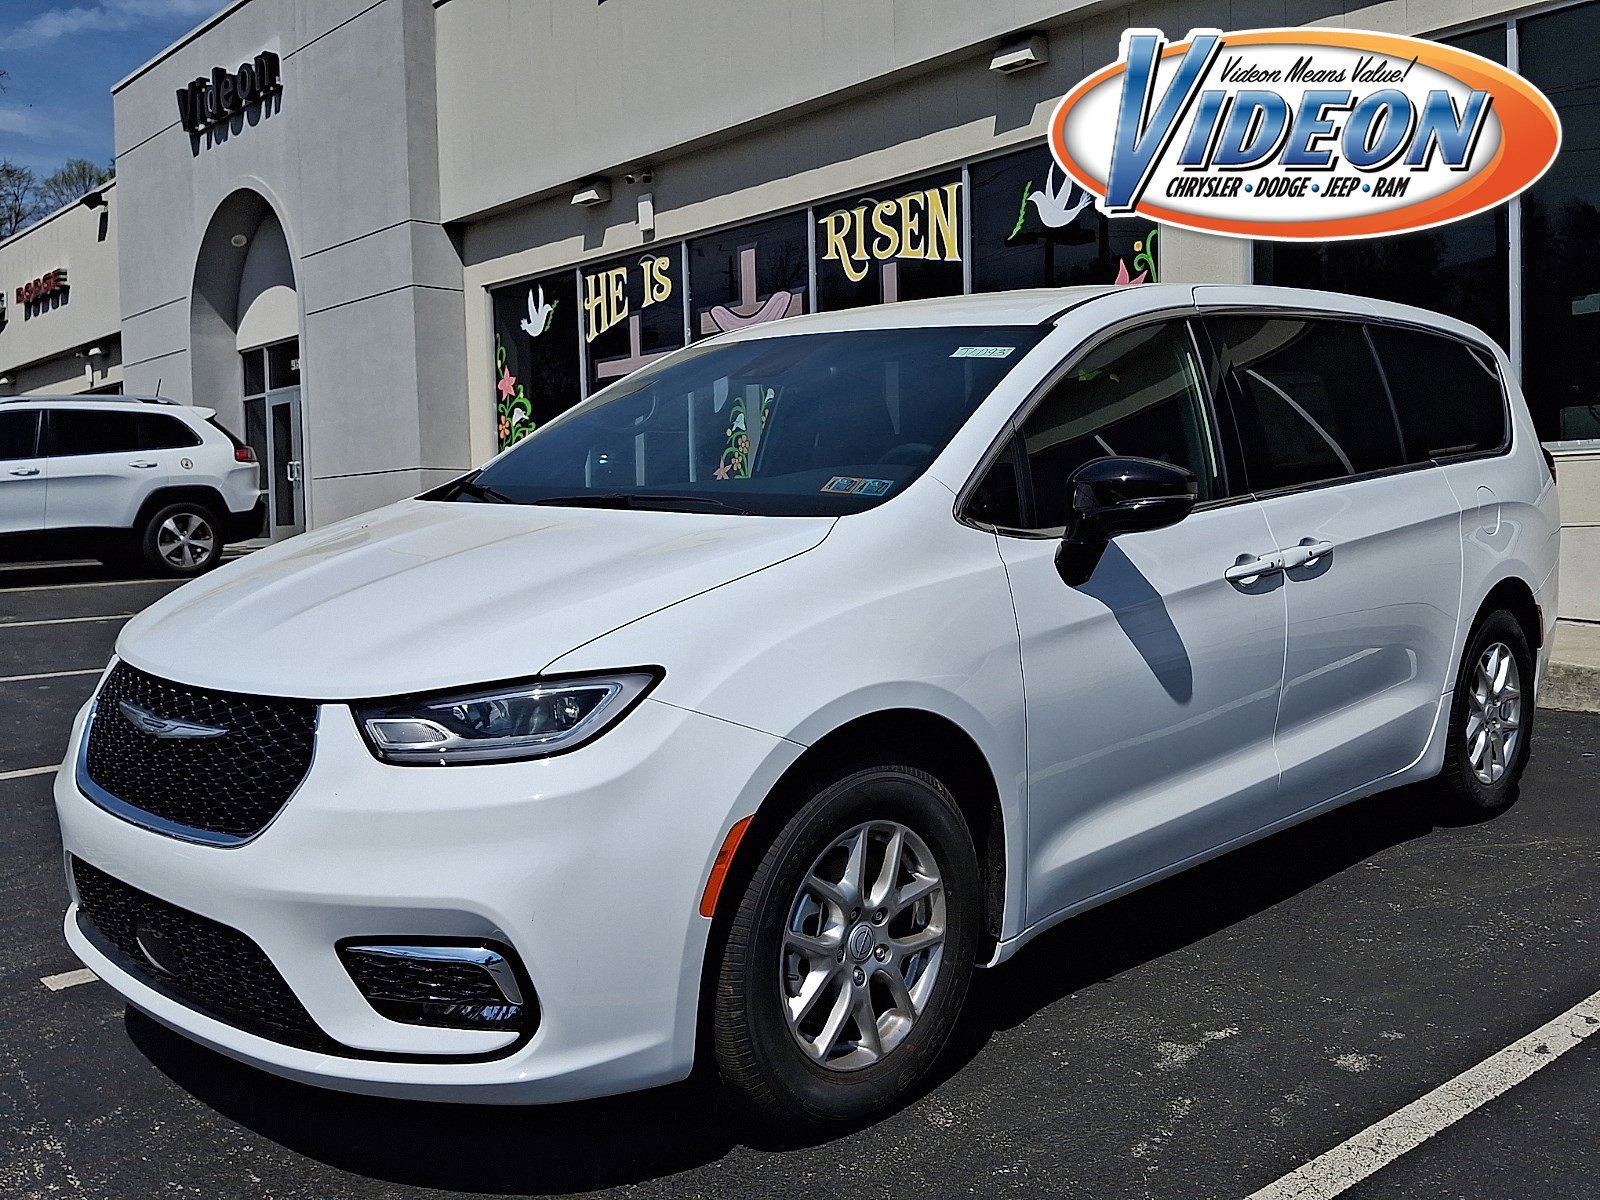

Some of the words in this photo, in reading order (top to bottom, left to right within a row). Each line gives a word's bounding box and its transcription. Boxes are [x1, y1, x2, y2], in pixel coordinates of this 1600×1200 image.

[176, 51, 281, 133] Videon
[16, 268, 68, 304] DODGE
[584, 267, 628, 343] HE
[640, 256, 672, 308] IS
[817, 182, 963, 282] RISEN
